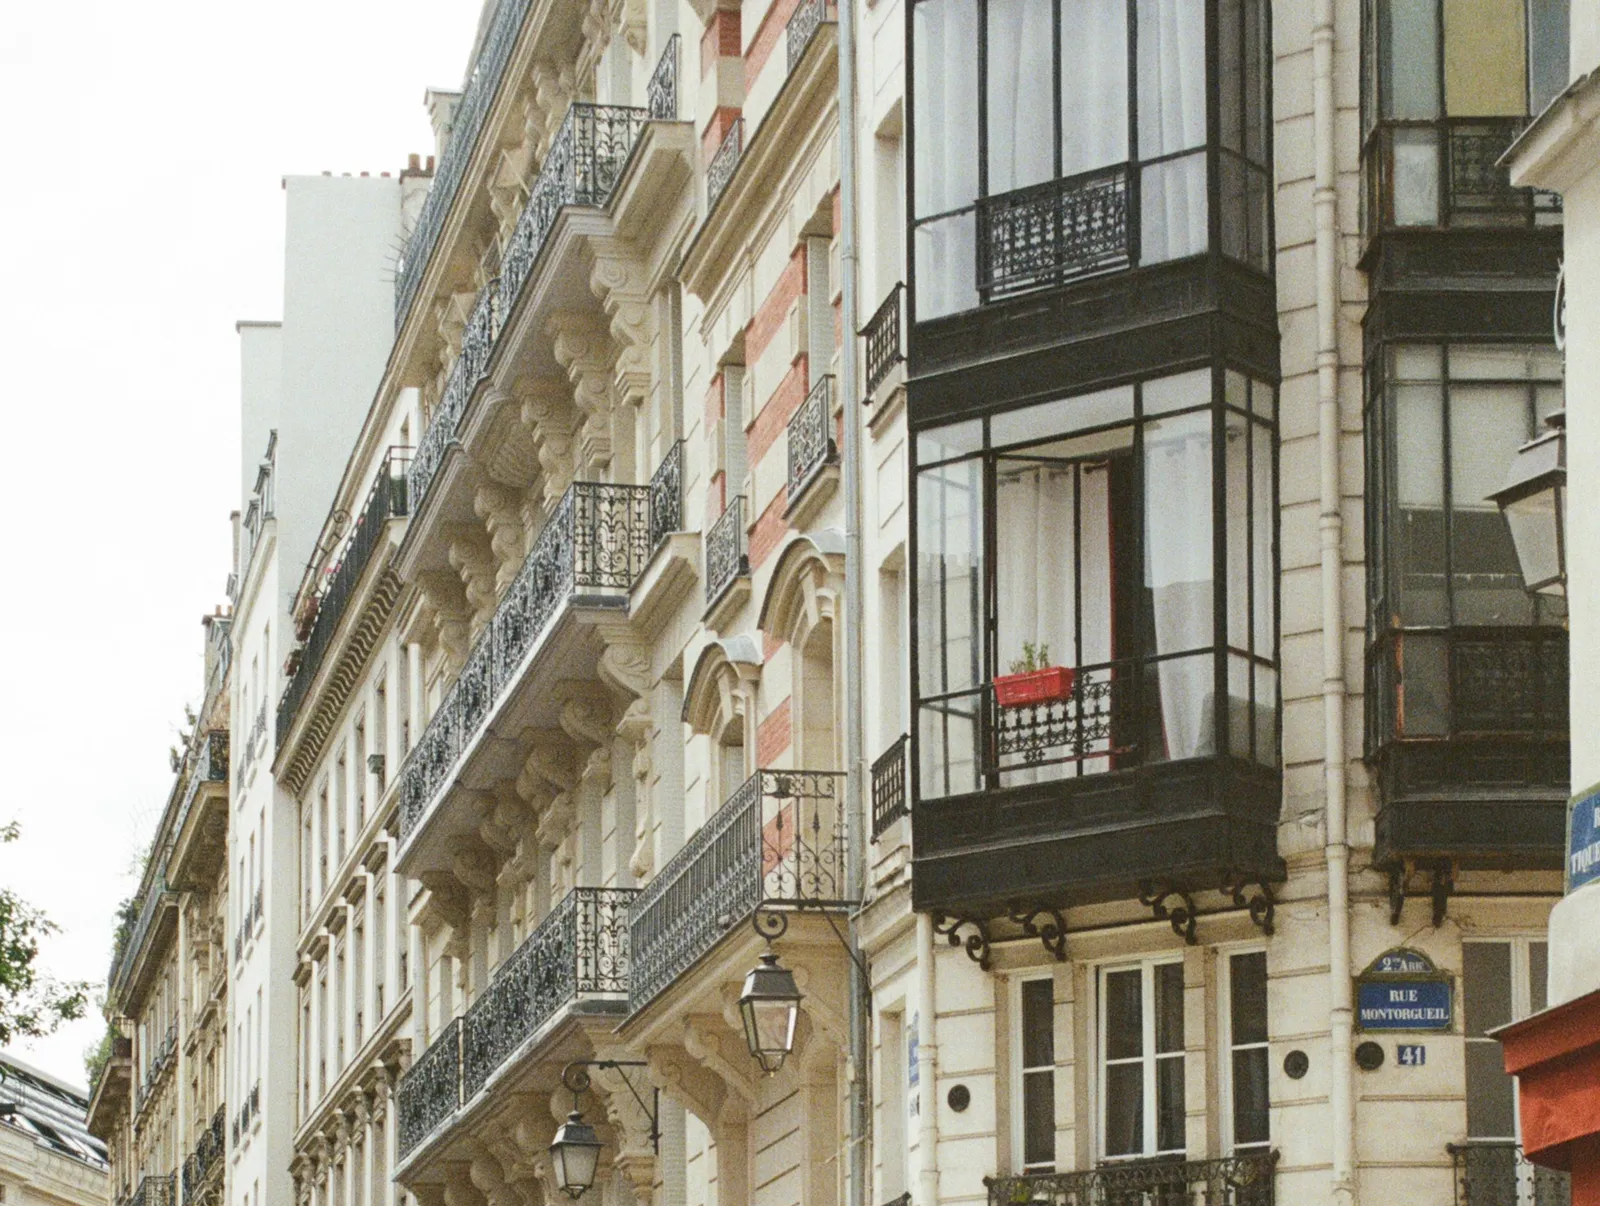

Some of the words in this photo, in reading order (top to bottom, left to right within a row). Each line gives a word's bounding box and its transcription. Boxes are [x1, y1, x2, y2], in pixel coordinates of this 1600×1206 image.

[1389, 989, 1418, 1002] RUE
[1360, 1007, 1449, 1020] MONTORGUEIL
[1402, 1046, 1422, 1065] 41
